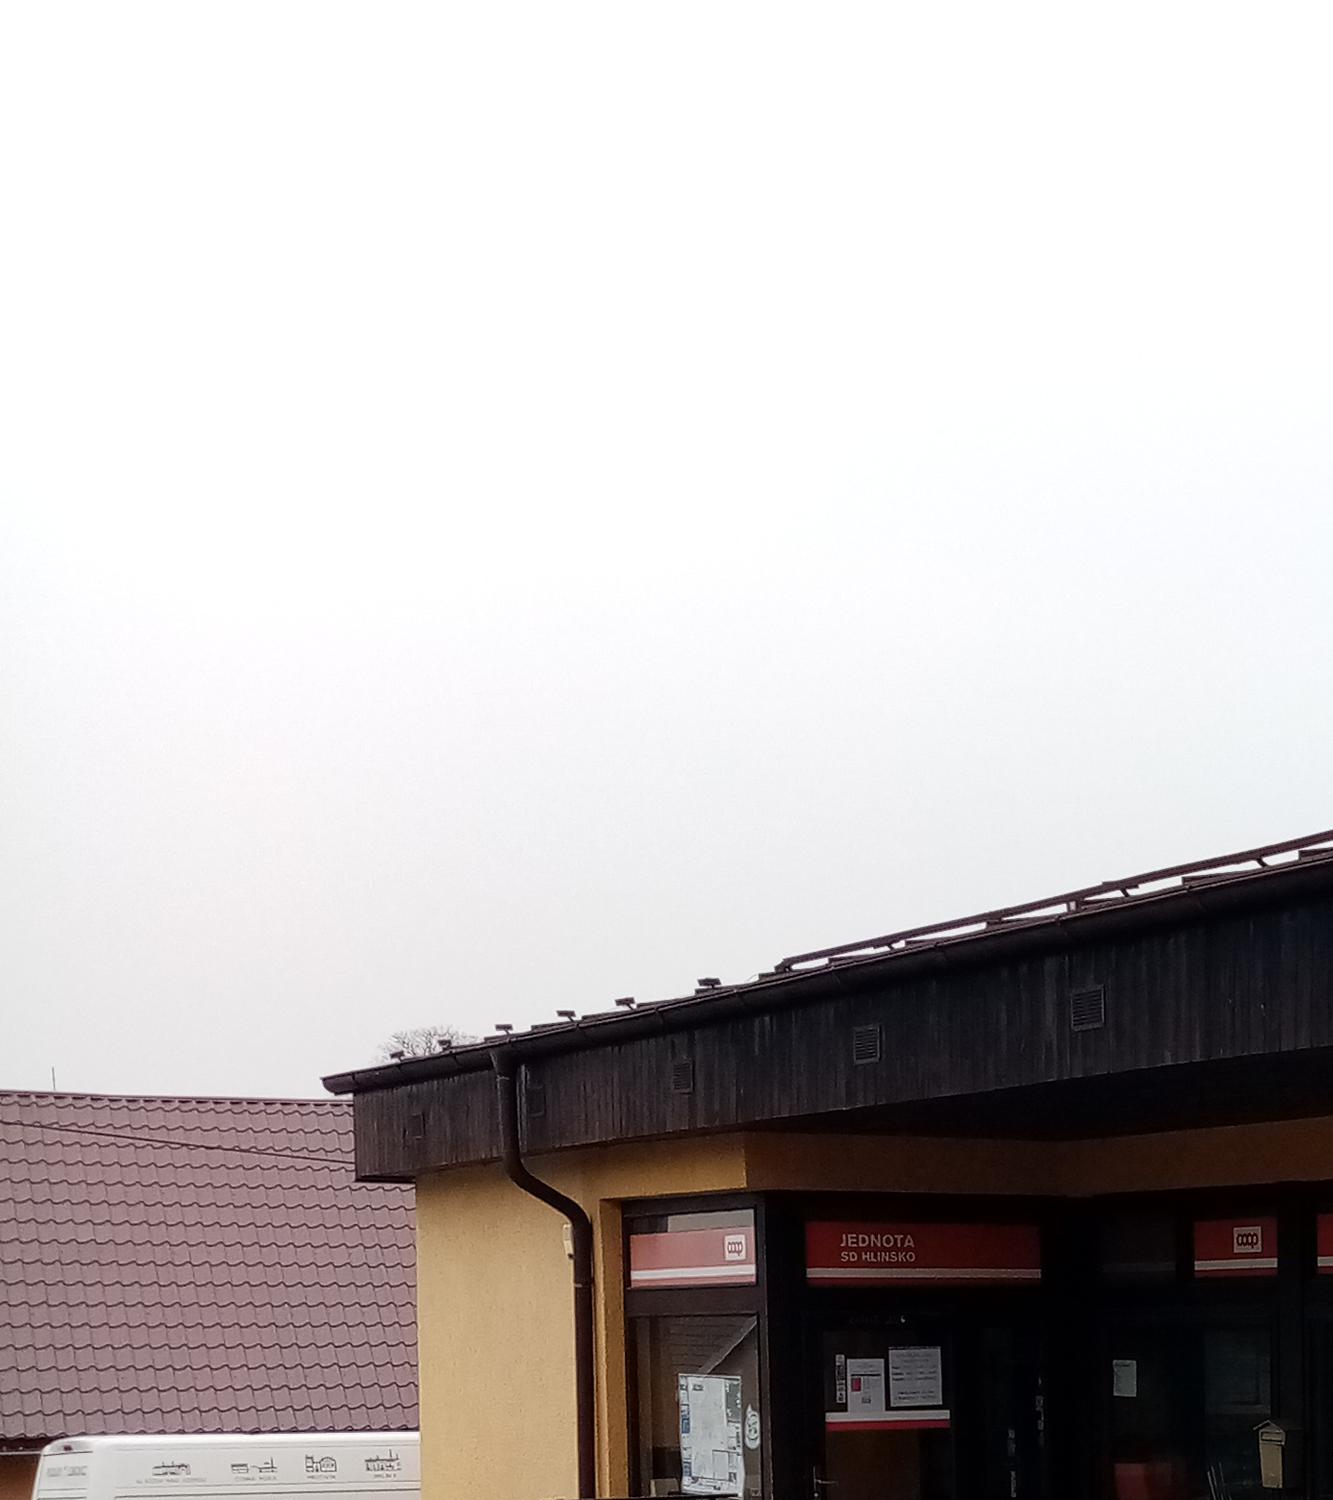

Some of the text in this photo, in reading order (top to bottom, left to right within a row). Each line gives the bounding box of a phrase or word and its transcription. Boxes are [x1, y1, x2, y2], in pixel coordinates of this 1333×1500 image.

[840, 1233, 915, 1248] JEDNOTA
[840, 1251, 916, 1262] SD HLINSKO
